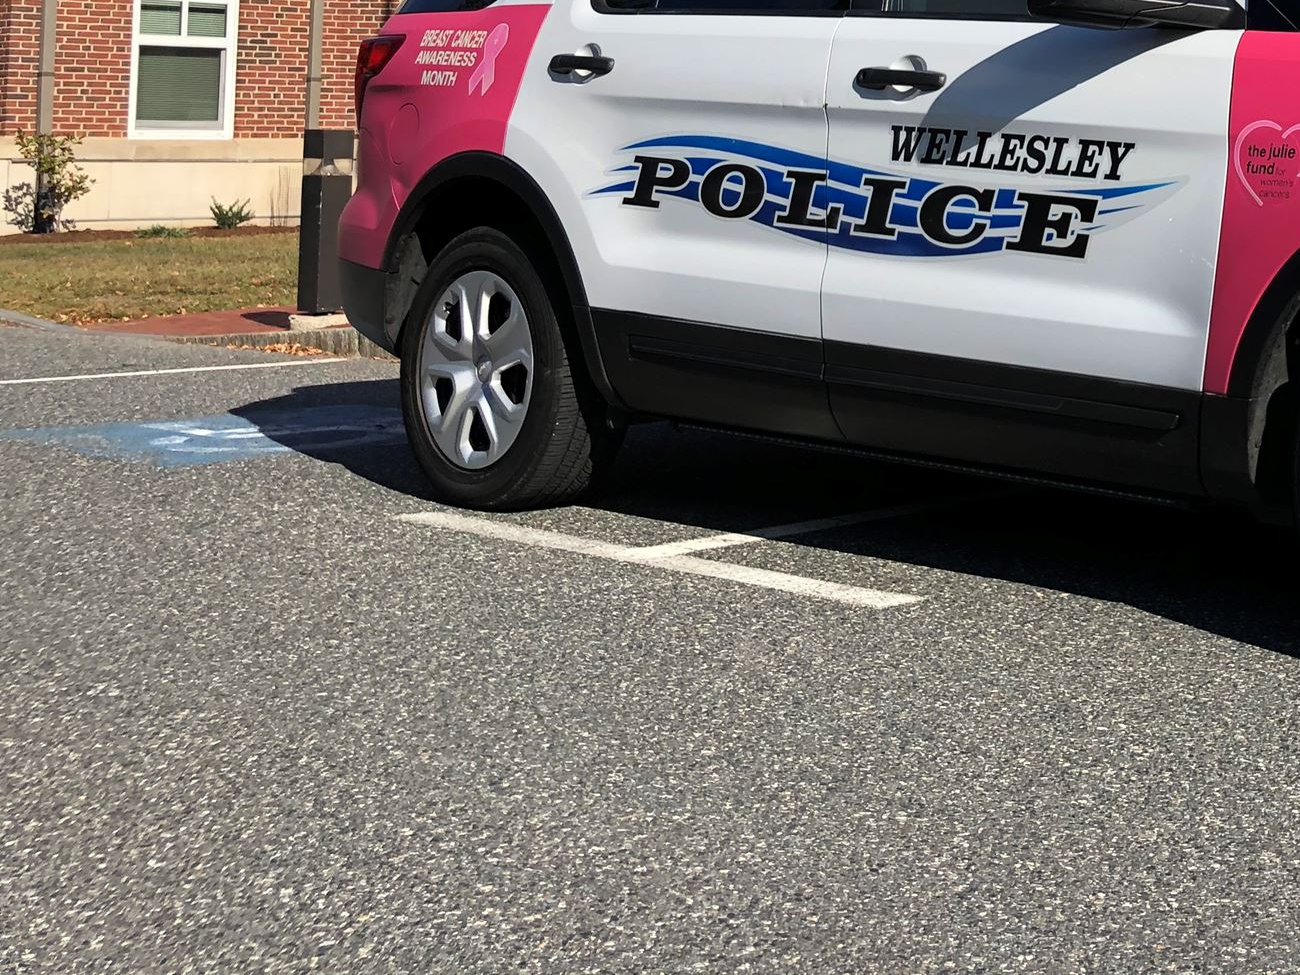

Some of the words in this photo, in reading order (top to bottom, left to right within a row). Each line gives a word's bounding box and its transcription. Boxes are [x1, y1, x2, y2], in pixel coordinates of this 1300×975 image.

[420, 29, 453, 47] BREAST
[452, 30, 488, 49] CANCER
[415, 50, 477, 67] AWARENESS
[420, 70, 458, 86] MONTH
[889, 124, 1136, 181] WELLESLEY
[1248, 144, 1267, 158] the
[1267, 142, 1296, 160] julie
[1246, 160, 1276, 175] fund
[621, 155, 1103, 260] POLICE
